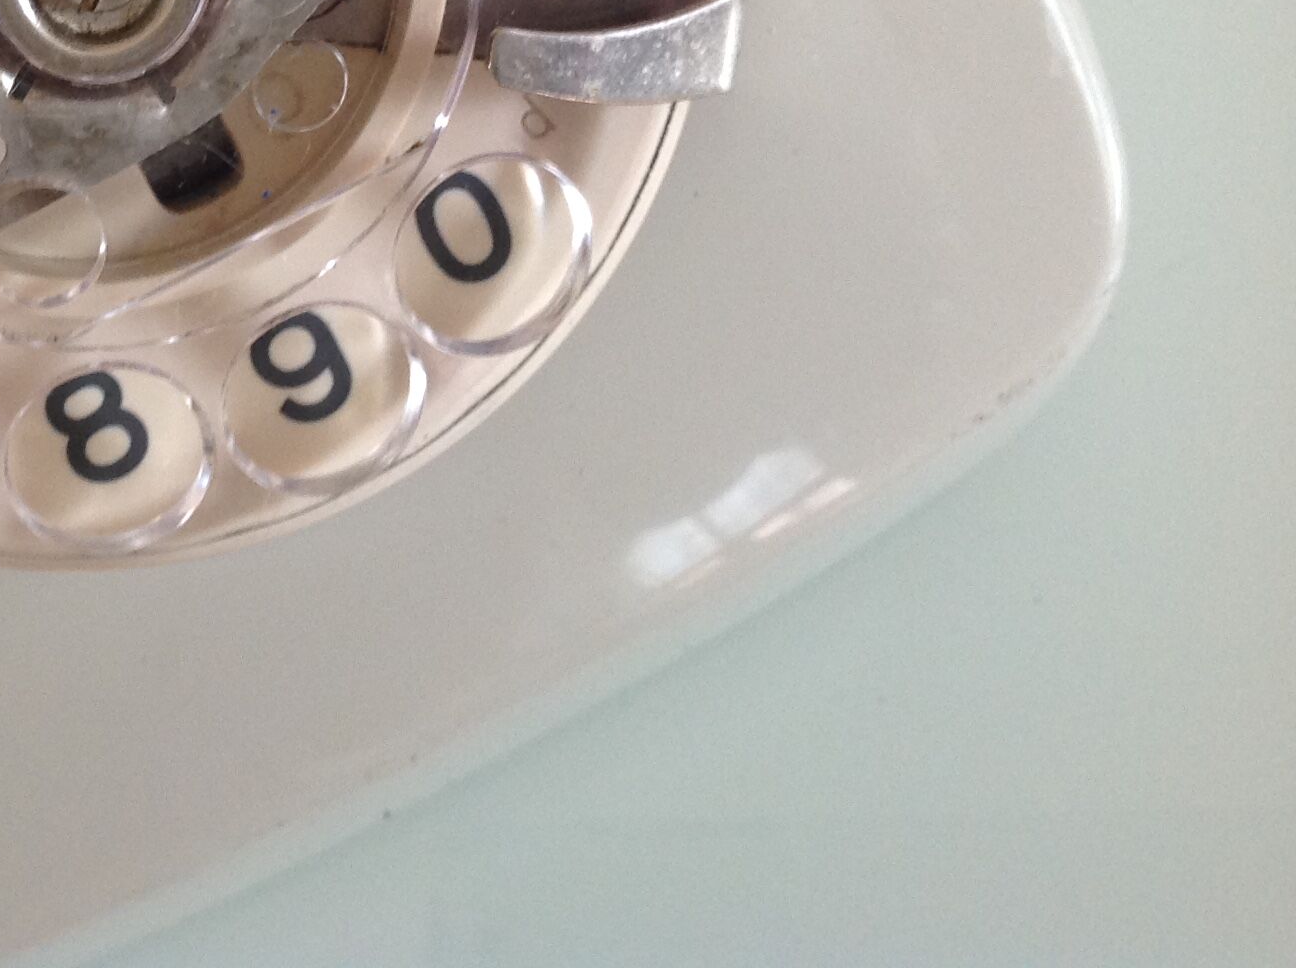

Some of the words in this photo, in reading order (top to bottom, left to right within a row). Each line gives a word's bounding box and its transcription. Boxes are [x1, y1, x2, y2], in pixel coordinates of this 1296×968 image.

[414, 170, 513, 284] 0
[249, 311, 353, 425] 9
[43, 370, 149, 483] 8
